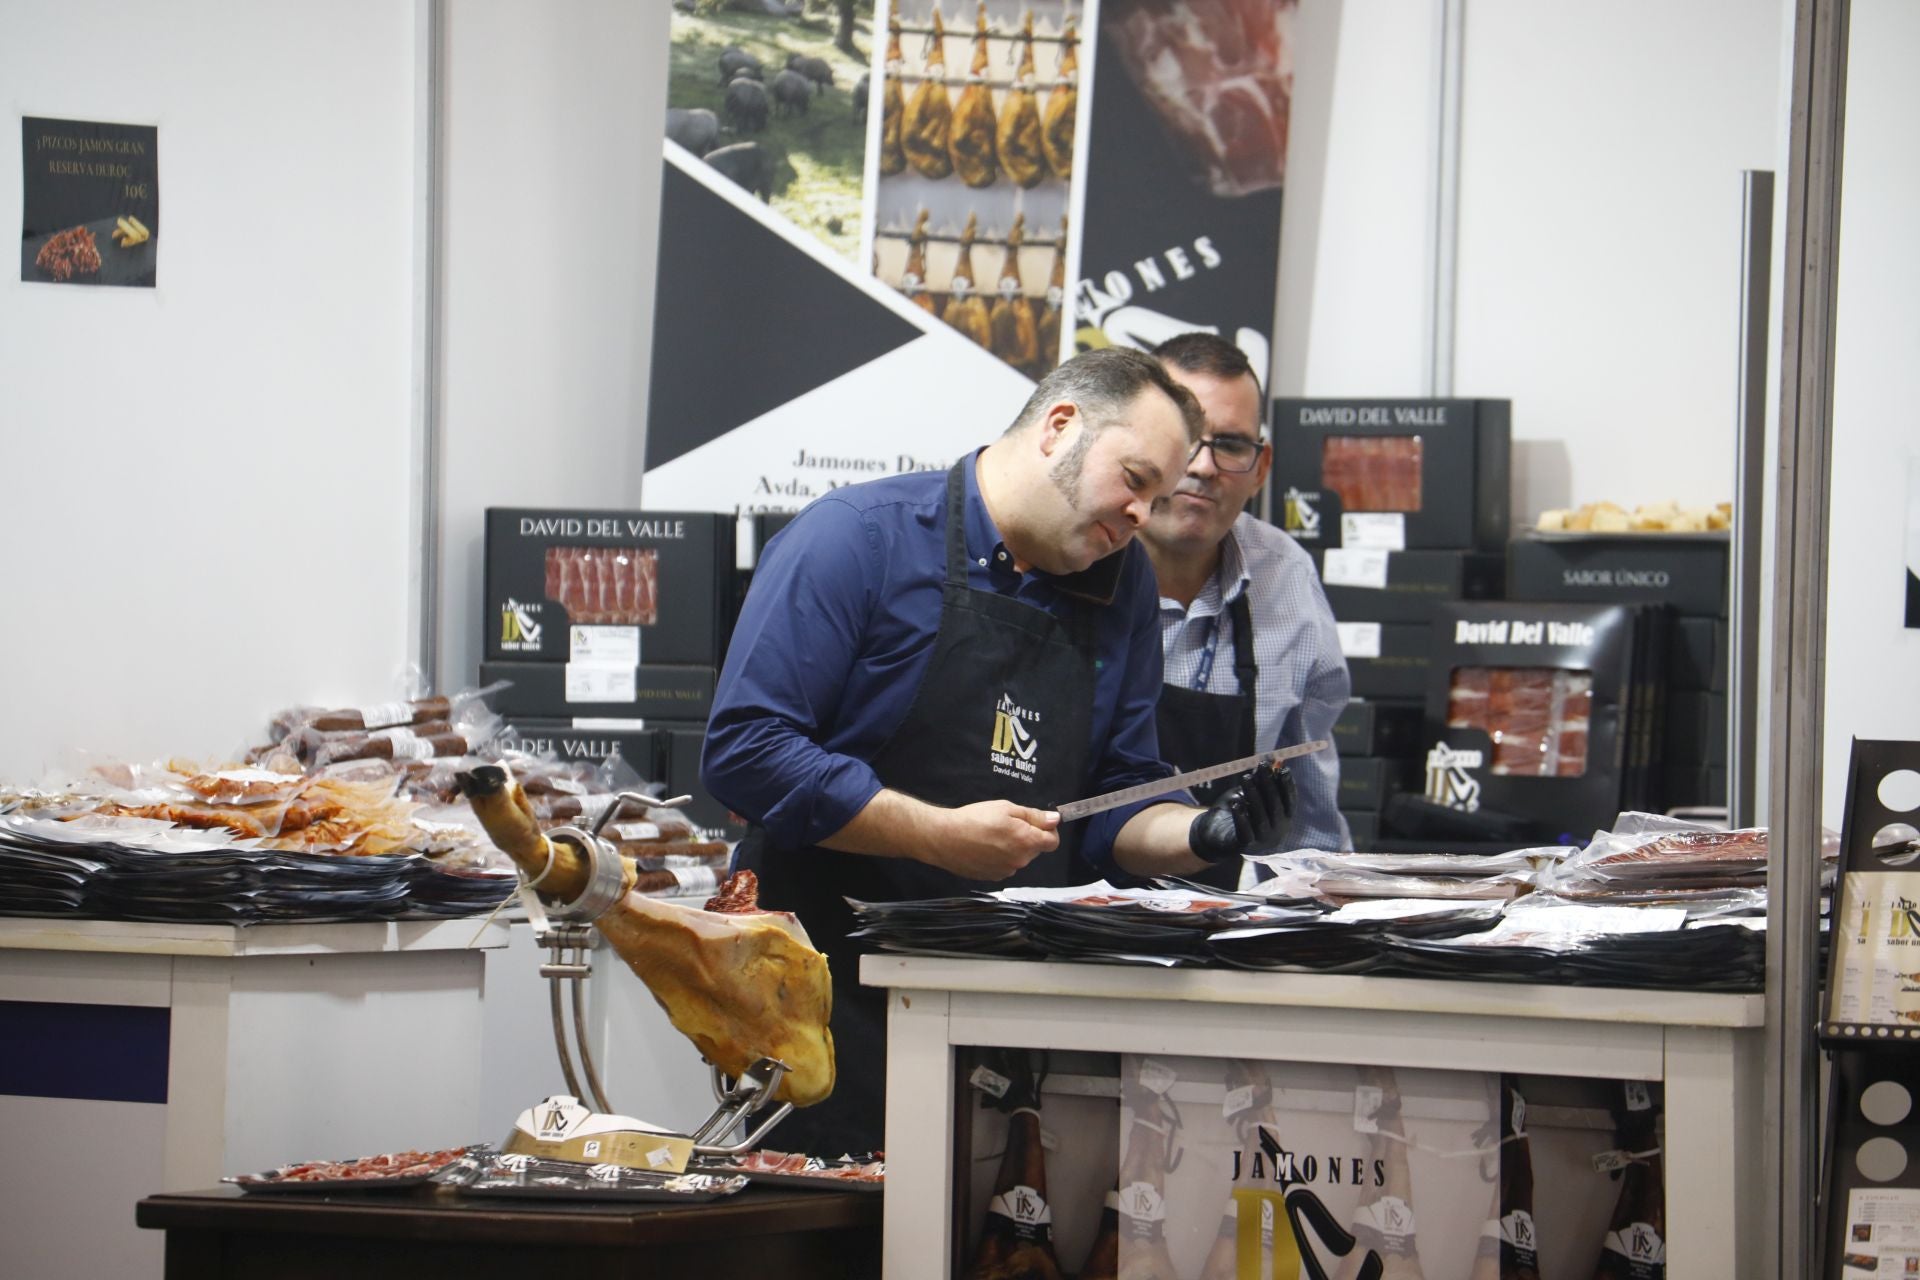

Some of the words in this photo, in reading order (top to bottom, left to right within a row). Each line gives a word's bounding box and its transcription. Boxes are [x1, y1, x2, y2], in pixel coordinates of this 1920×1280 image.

[1300, 407, 1356, 426] DAVID
[1358, 407, 1390, 426] DEL
[1393, 407, 1447, 426] VALLE
[793, 449, 887, 473] Jamones
[755, 475, 817, 498] Avda.
[520, 518, 582, 537] DAVID
[587, 519, 623, 537] DEL
[627, 520, 686, 539] VALLE
[1563, 570, 1612, 587] SABOR
[1455, 620, 1508, 645] David
[1509, 620, 1543, 645] Del
[1547, 620, 1595, 646] Valle
[563, 739, 623, 758] VALLE
[991, 751, 1014, 767] sabor
[1232, 1150, 1386, 1187] JAMONES
